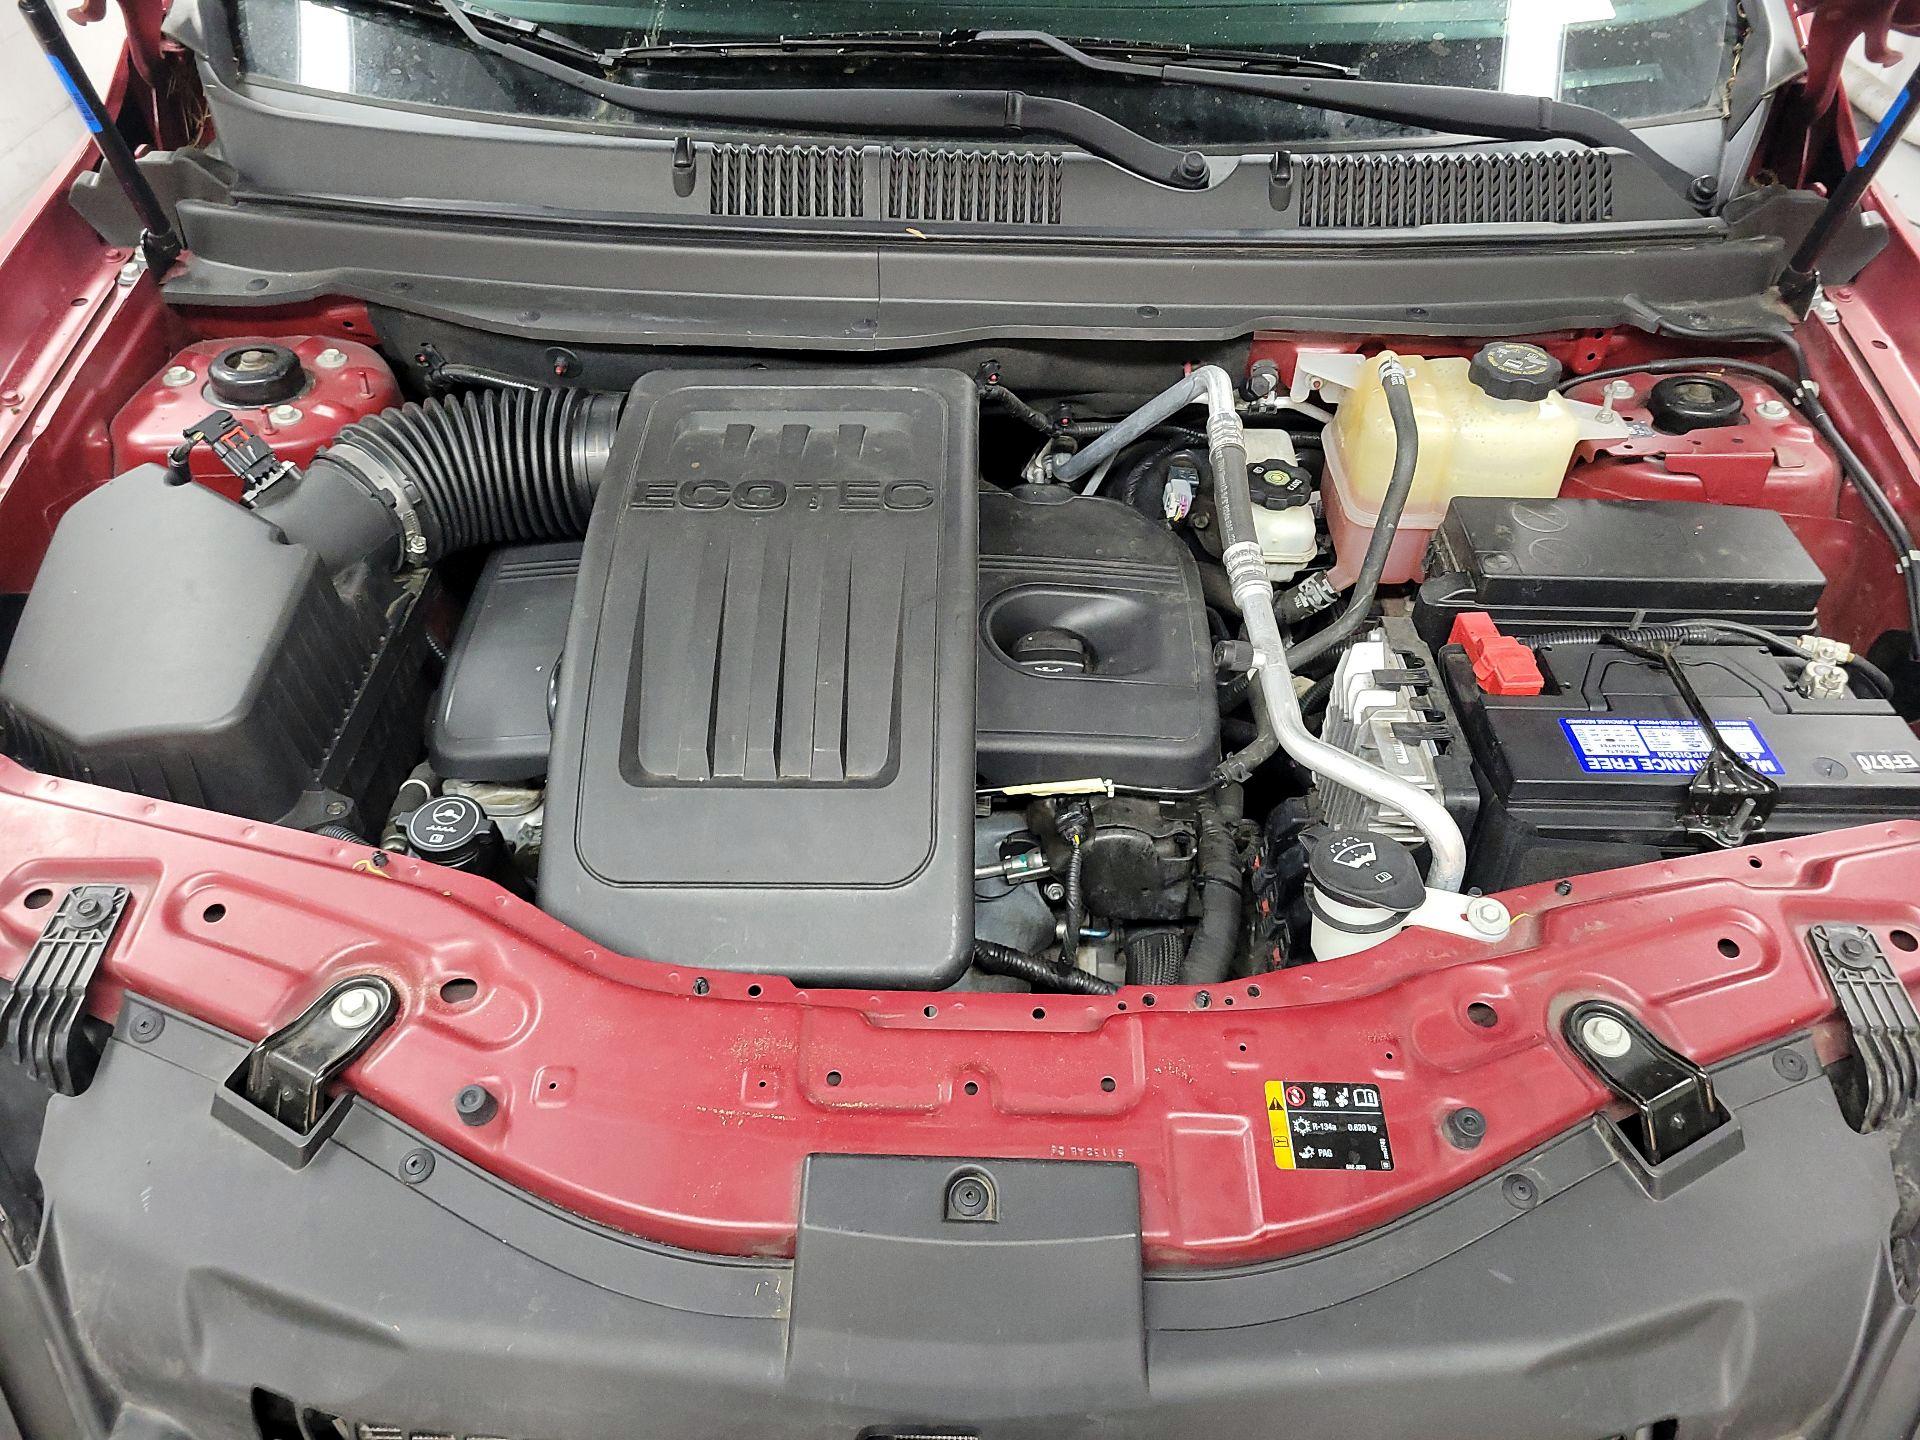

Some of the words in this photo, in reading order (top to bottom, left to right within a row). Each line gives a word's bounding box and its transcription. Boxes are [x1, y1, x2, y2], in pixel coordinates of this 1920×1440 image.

[630, 480, 934, 511] ECOTEC
[1584, 757, 1638, 770] FREE
[1638, 758, 1777, 772] MANANCE
[1856, 754, 1920, 770] EFB70
[1312, 1100, 1330, 1108] AUTO
[1312, 1122, 1337, 1131] R-134a
[1367, 1123, 1378, 1134] kg
[1317, 1148, 1334, 1158] PAG
